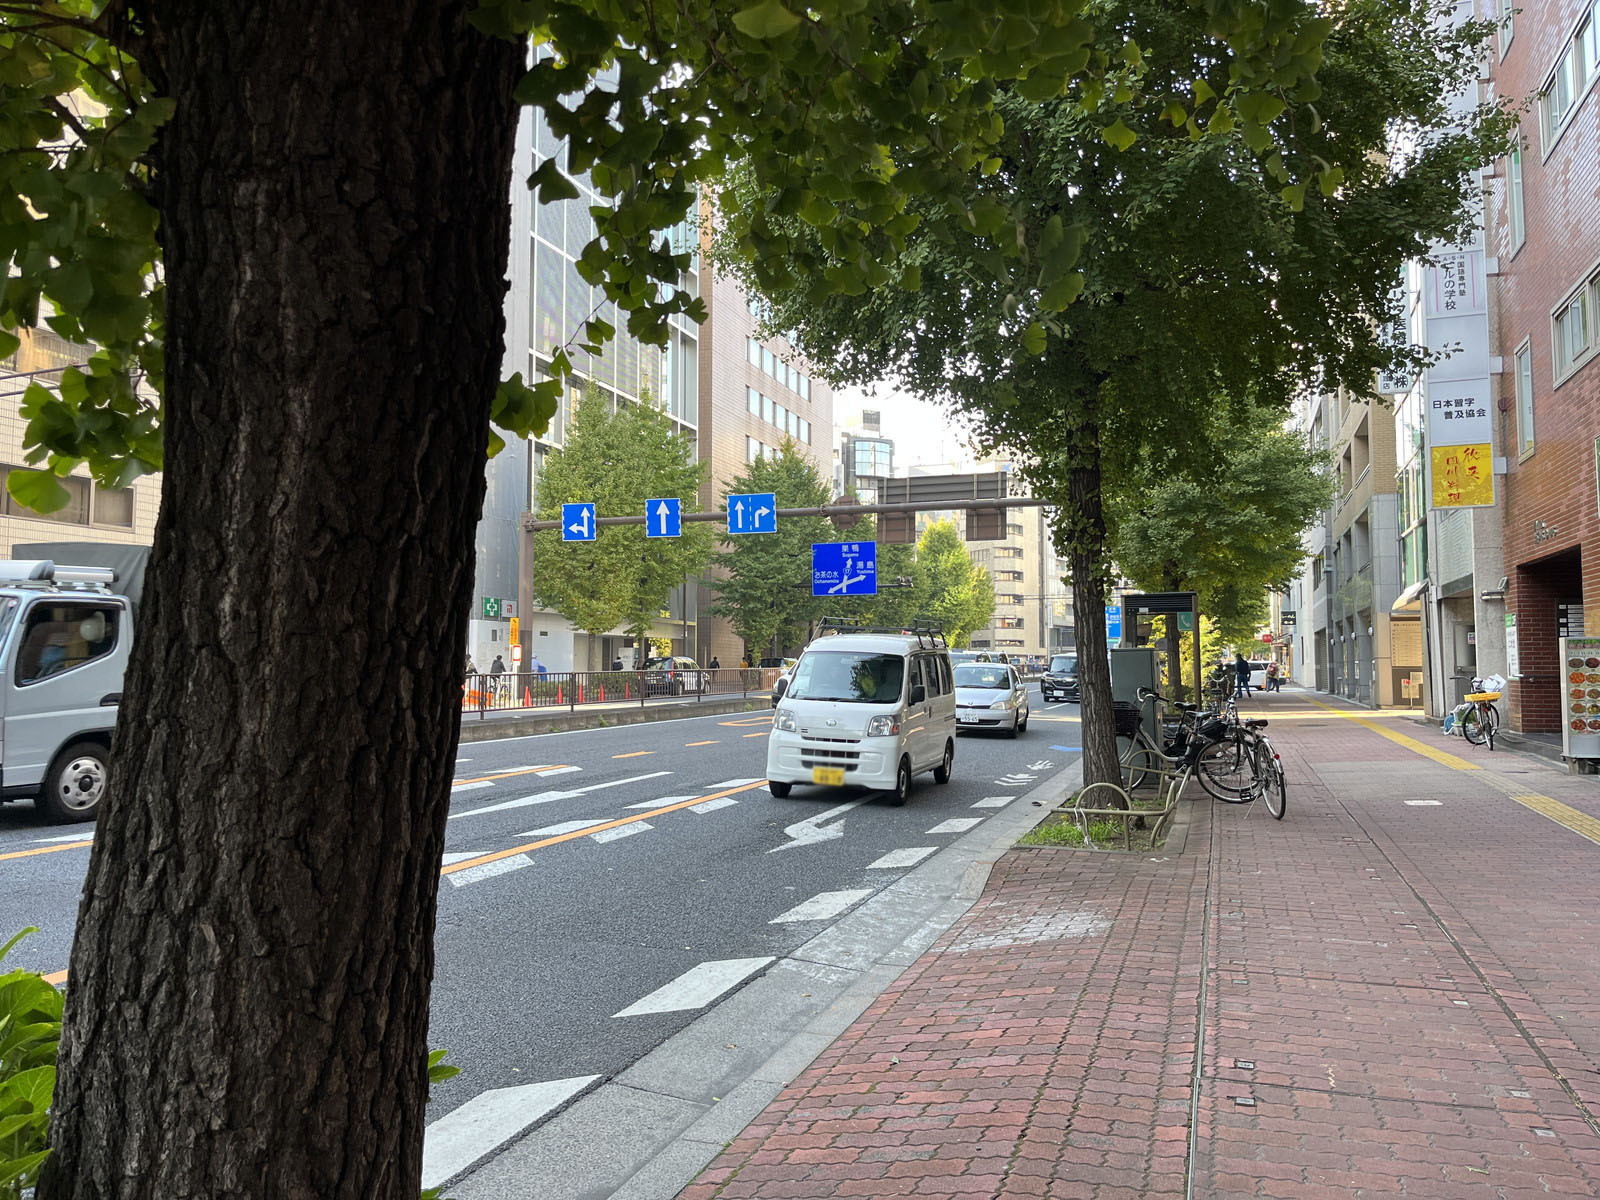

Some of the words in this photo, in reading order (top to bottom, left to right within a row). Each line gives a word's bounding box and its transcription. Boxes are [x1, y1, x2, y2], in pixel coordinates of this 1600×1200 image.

[1457, 261, 1466, 296] 国語専門塾
[1432, 398, 1475, 408] 日本習字
[1443, 408, 1487, 420] 普及協会
